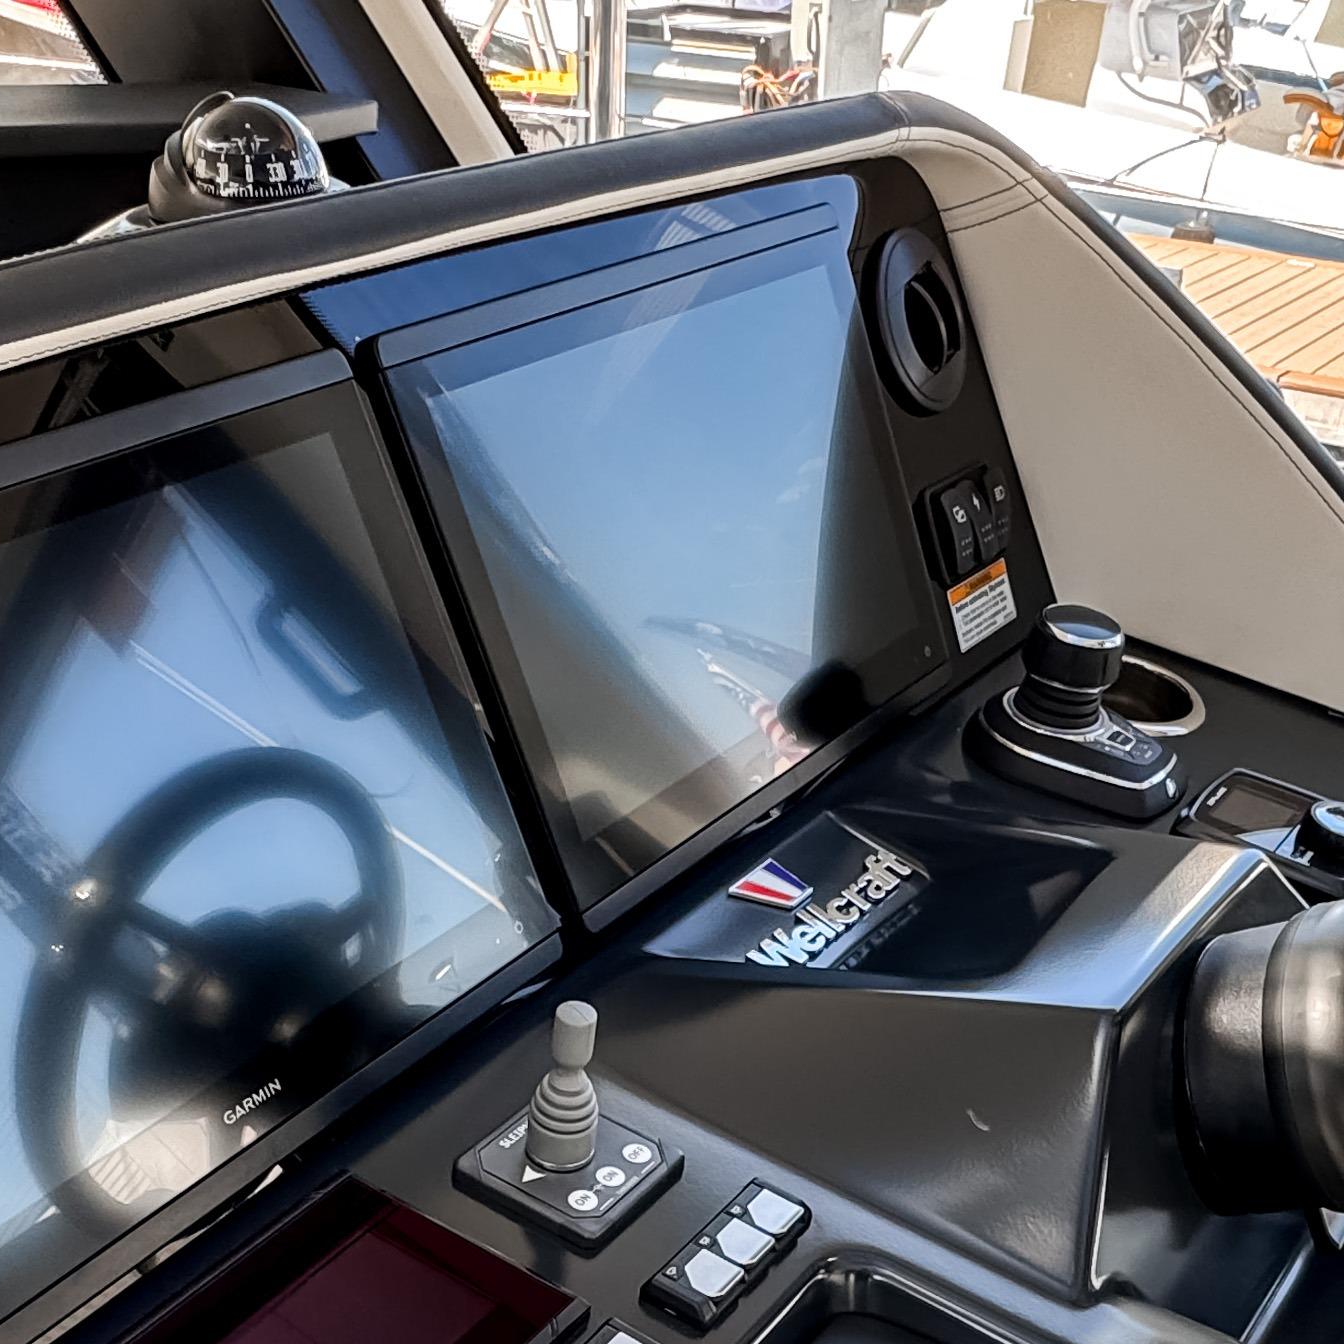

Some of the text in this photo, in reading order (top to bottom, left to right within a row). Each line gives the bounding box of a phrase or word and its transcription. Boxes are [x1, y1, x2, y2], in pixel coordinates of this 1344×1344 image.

[745, 849, 913, 968] Wellcraft
[223, 1078, 282, 1125] GARMIN
[627, 1146, 646, 1160] OFF
[603, 1171, 619, 1183] ON
[574, 1194, 592, 1207] ON
